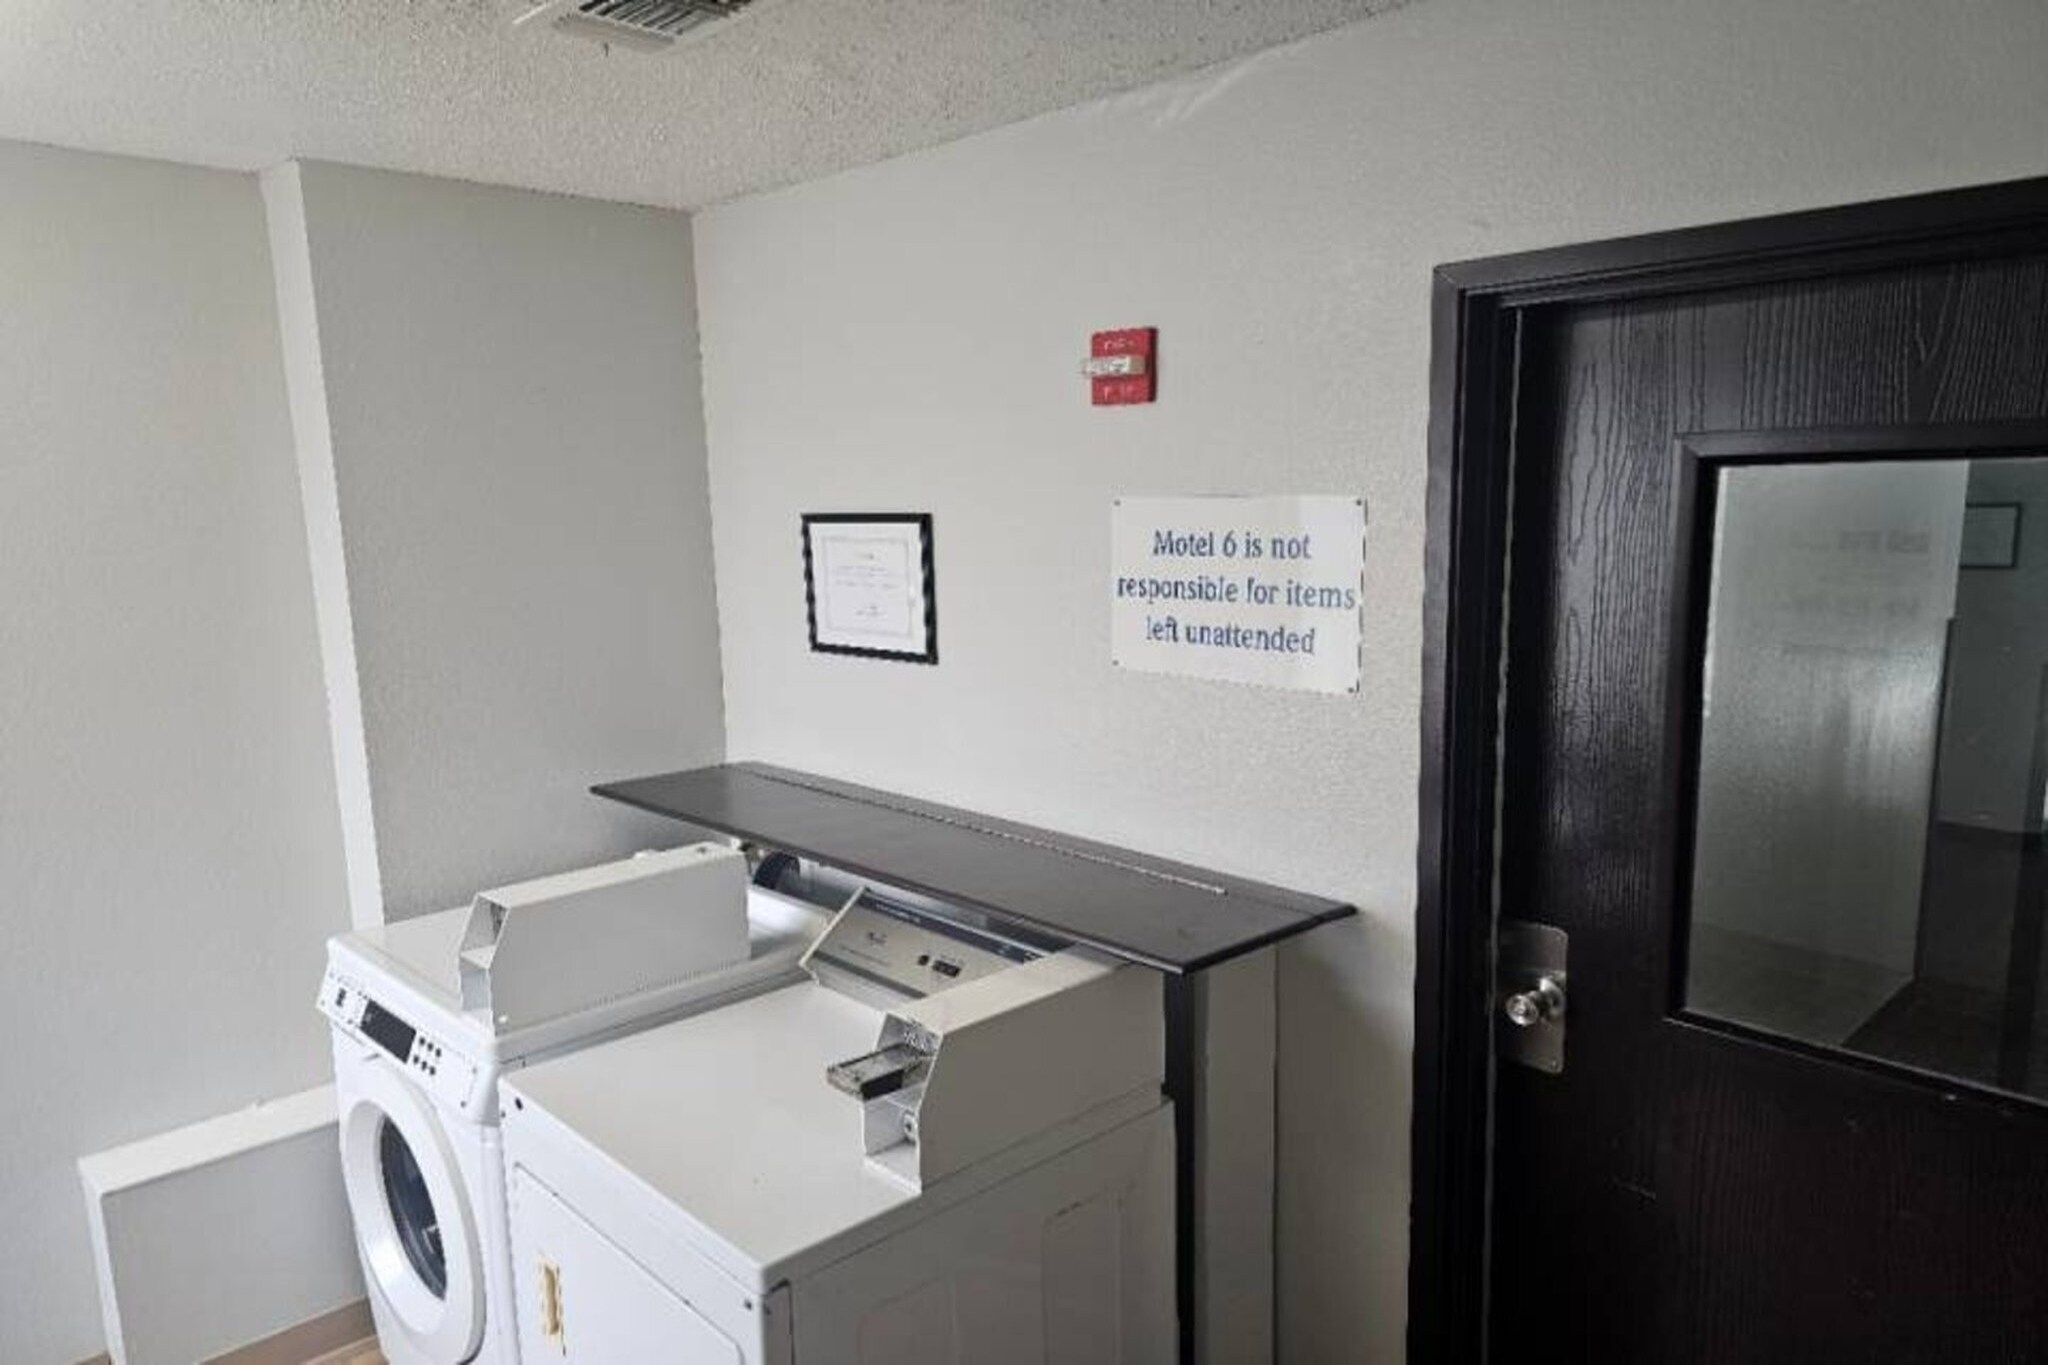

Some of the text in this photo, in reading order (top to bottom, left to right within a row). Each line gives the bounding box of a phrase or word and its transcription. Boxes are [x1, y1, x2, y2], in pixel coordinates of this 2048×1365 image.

[1152, 529, 1312, 560] Motel 6 is not
[1117, 574, 1355, 609] responsible for items
[1146, 615, 1316, 654] left unattended
